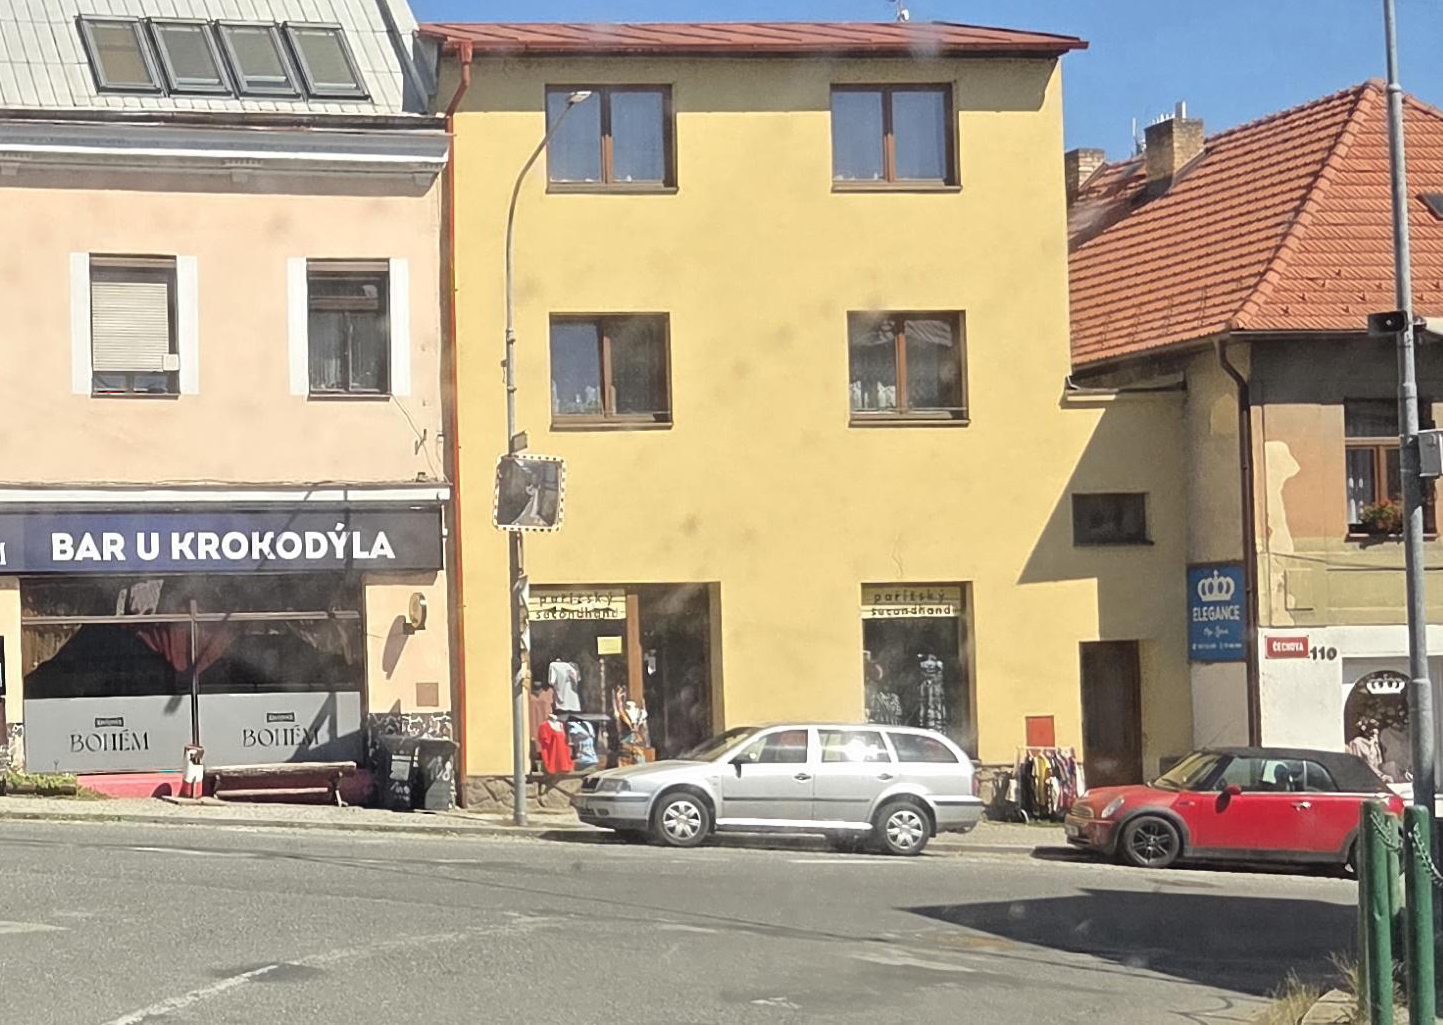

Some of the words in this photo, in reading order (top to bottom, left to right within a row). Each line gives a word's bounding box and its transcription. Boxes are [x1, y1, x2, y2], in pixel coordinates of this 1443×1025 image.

[51, 532, 126, 561] BAR
[136, 532, 160, 560] U
[170, 522, 396, 560] KROKODÝLA
[1192, 605, 1240, 622] ELEGANCE
[1310, 646, 1337, 661] 110
[70, 728, 149, 752] BOHÉM
[243, 724, 319, 747] BOHÉM
